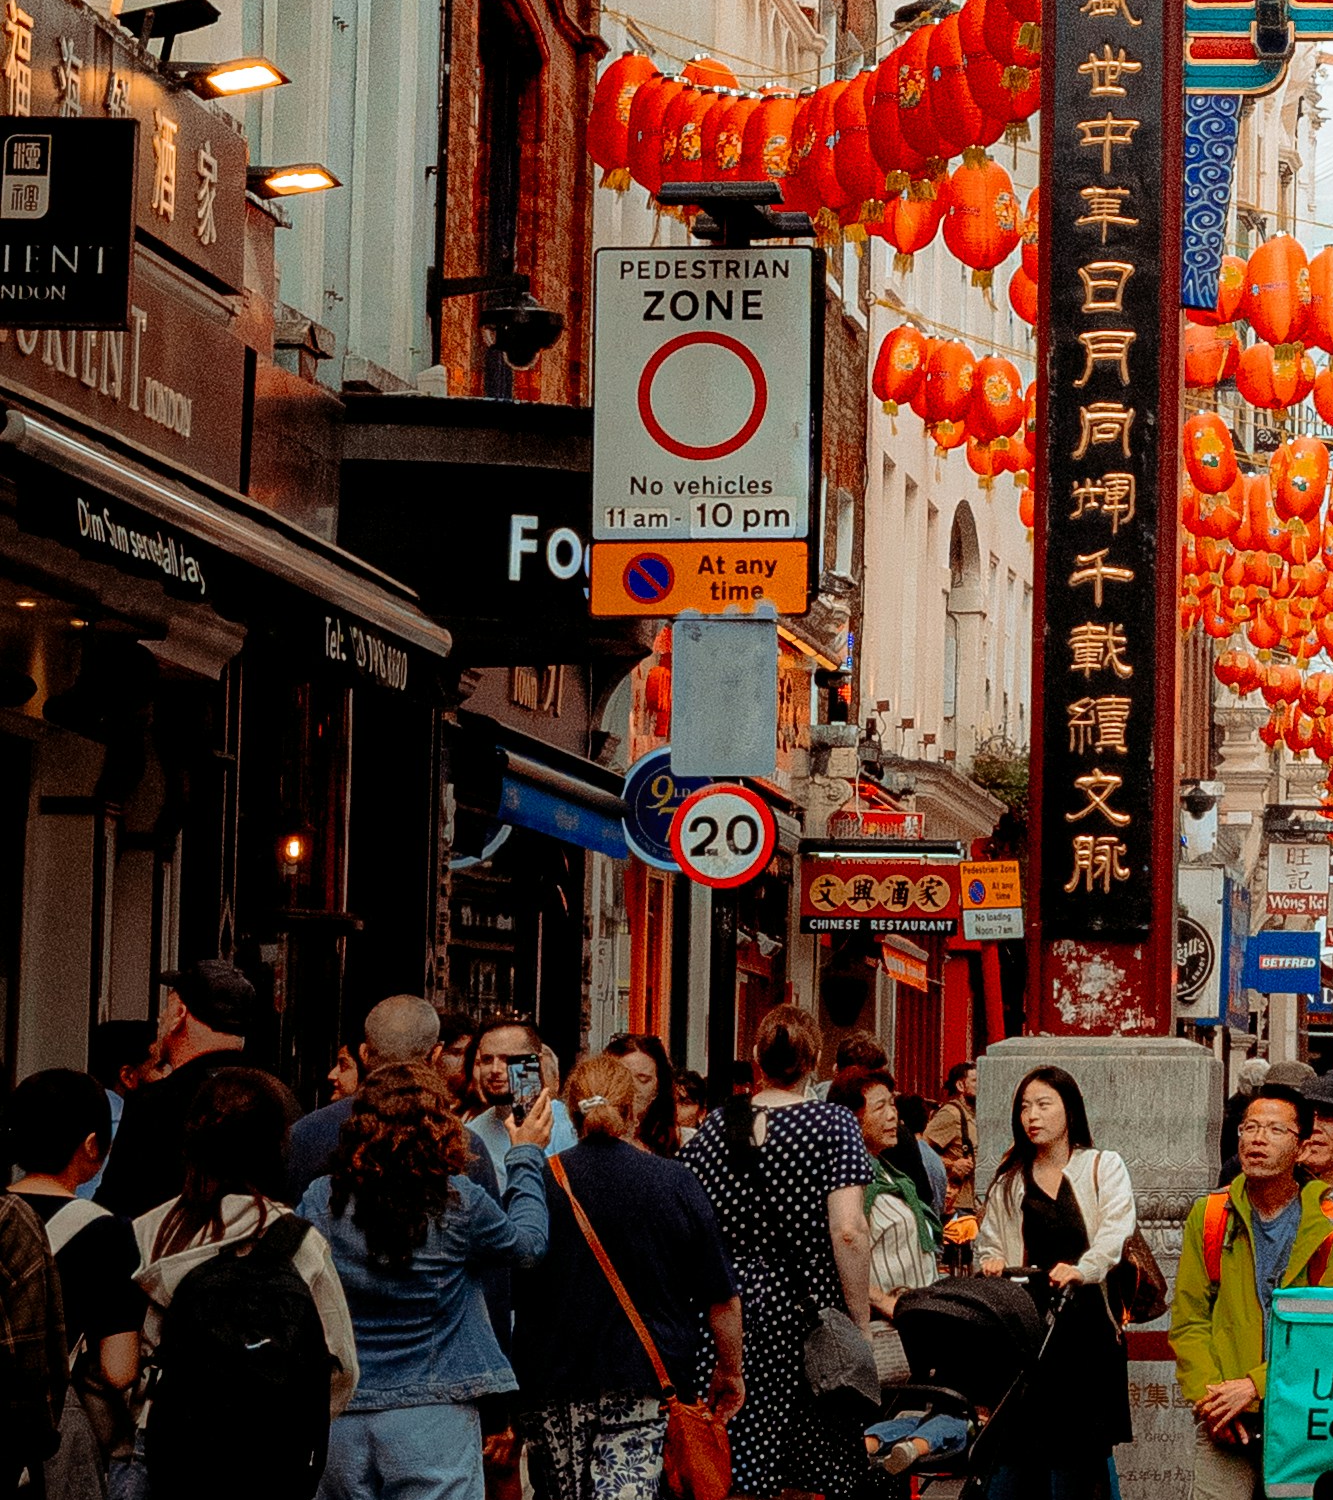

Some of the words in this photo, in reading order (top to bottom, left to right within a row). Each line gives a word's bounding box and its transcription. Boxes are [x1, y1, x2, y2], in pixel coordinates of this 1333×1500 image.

[620, 259, 790, 280] PEDESTRIAN
[643, 290, 764, 321] ZONE
[630, 476, 663, 495] No
[674, 475, 773, 495] vehicles
[77, 497, 106, 542] Dim
[606, 509, 627, 527] 11
[633, 511, 668, 527] am
[696, 503, 733, 528] 10
[743, 506, 791, 532] pm
[698, 556, 725, 575] At
[735, 557, 777, 579] any
[710, 581, 764, 600] time
[689, 814, 759, 858] 20
[814, 878, 943, 908] 文興酒家
[1269, 895, 1304, 912] Wong
[1308, 896, 1327, 911] Kei
[809, 919, 860, 931] CHINESE
[870, 920, 954, 931] RESTAURANT
[1261, 957, 1316, 969] BETFRED
